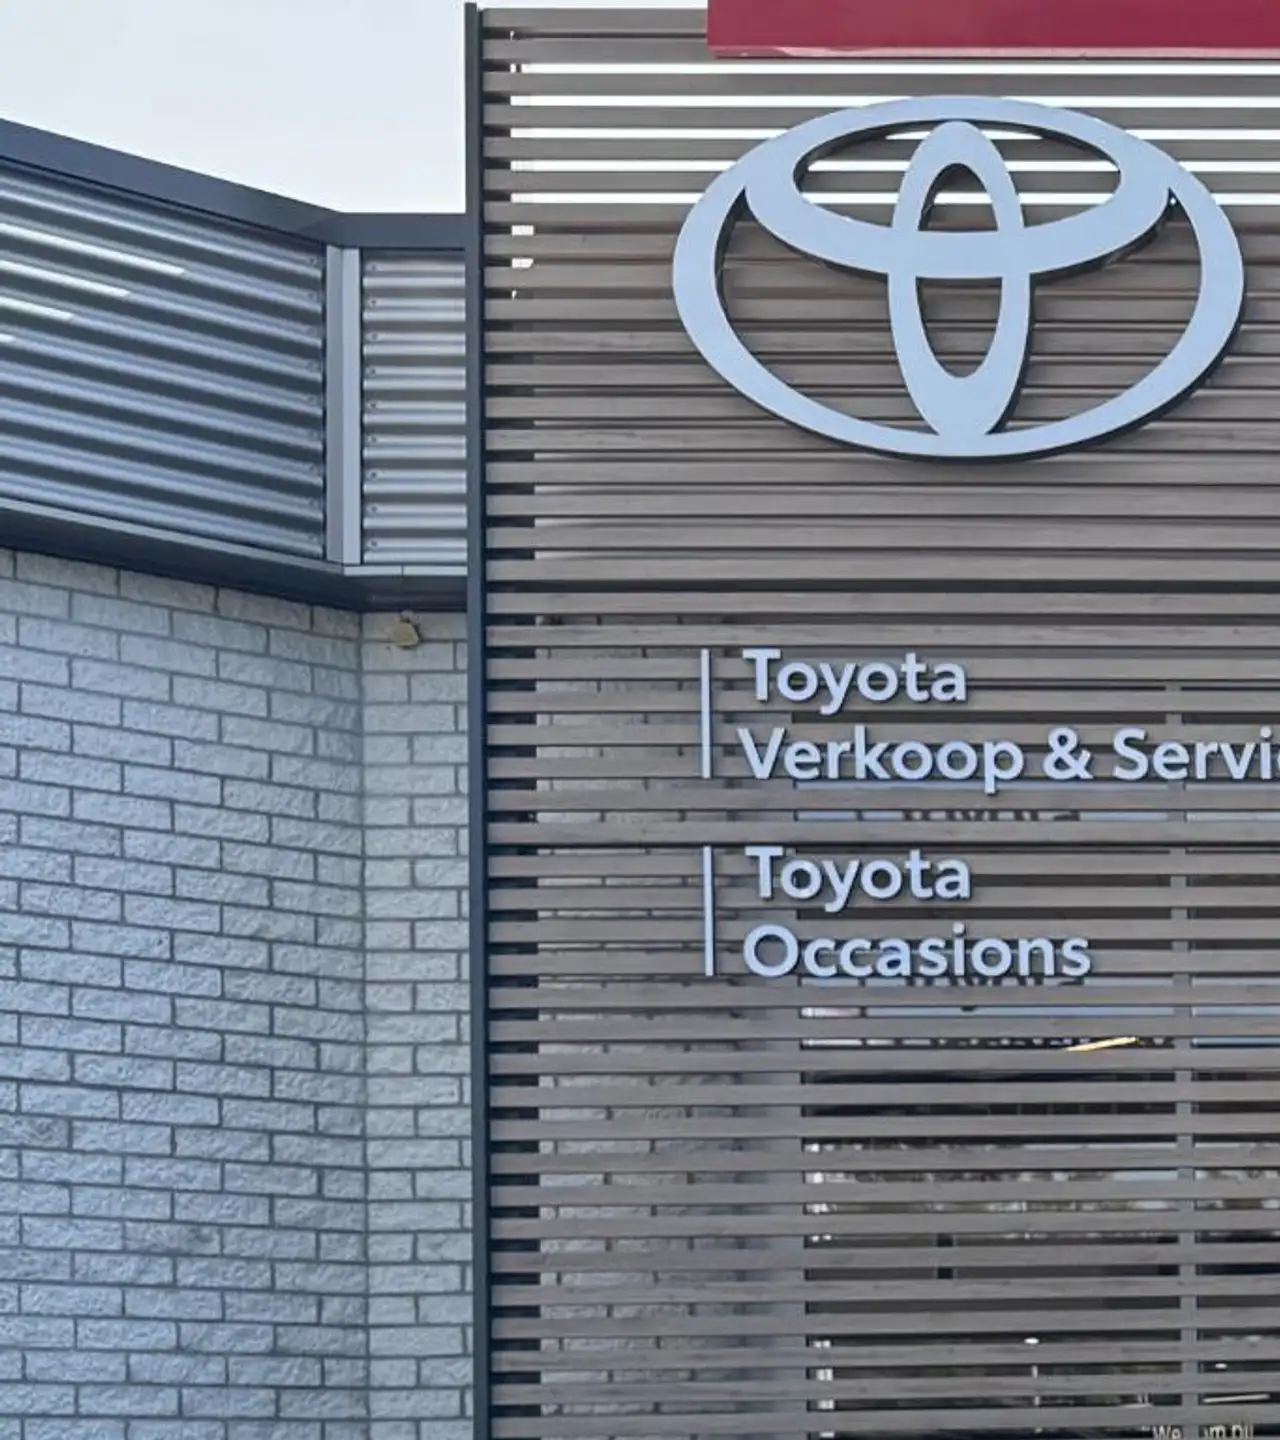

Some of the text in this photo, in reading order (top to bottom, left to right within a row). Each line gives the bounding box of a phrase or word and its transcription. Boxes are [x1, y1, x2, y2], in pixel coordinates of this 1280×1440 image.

[742, 648, 968, 715] Toyota
[737, 724, 1024, 795] Verkoop
[1042, 727, 1093, 781] &
[744, 845, 972, 912] Toyota
[742, 922, 1092, 978] Occasions
